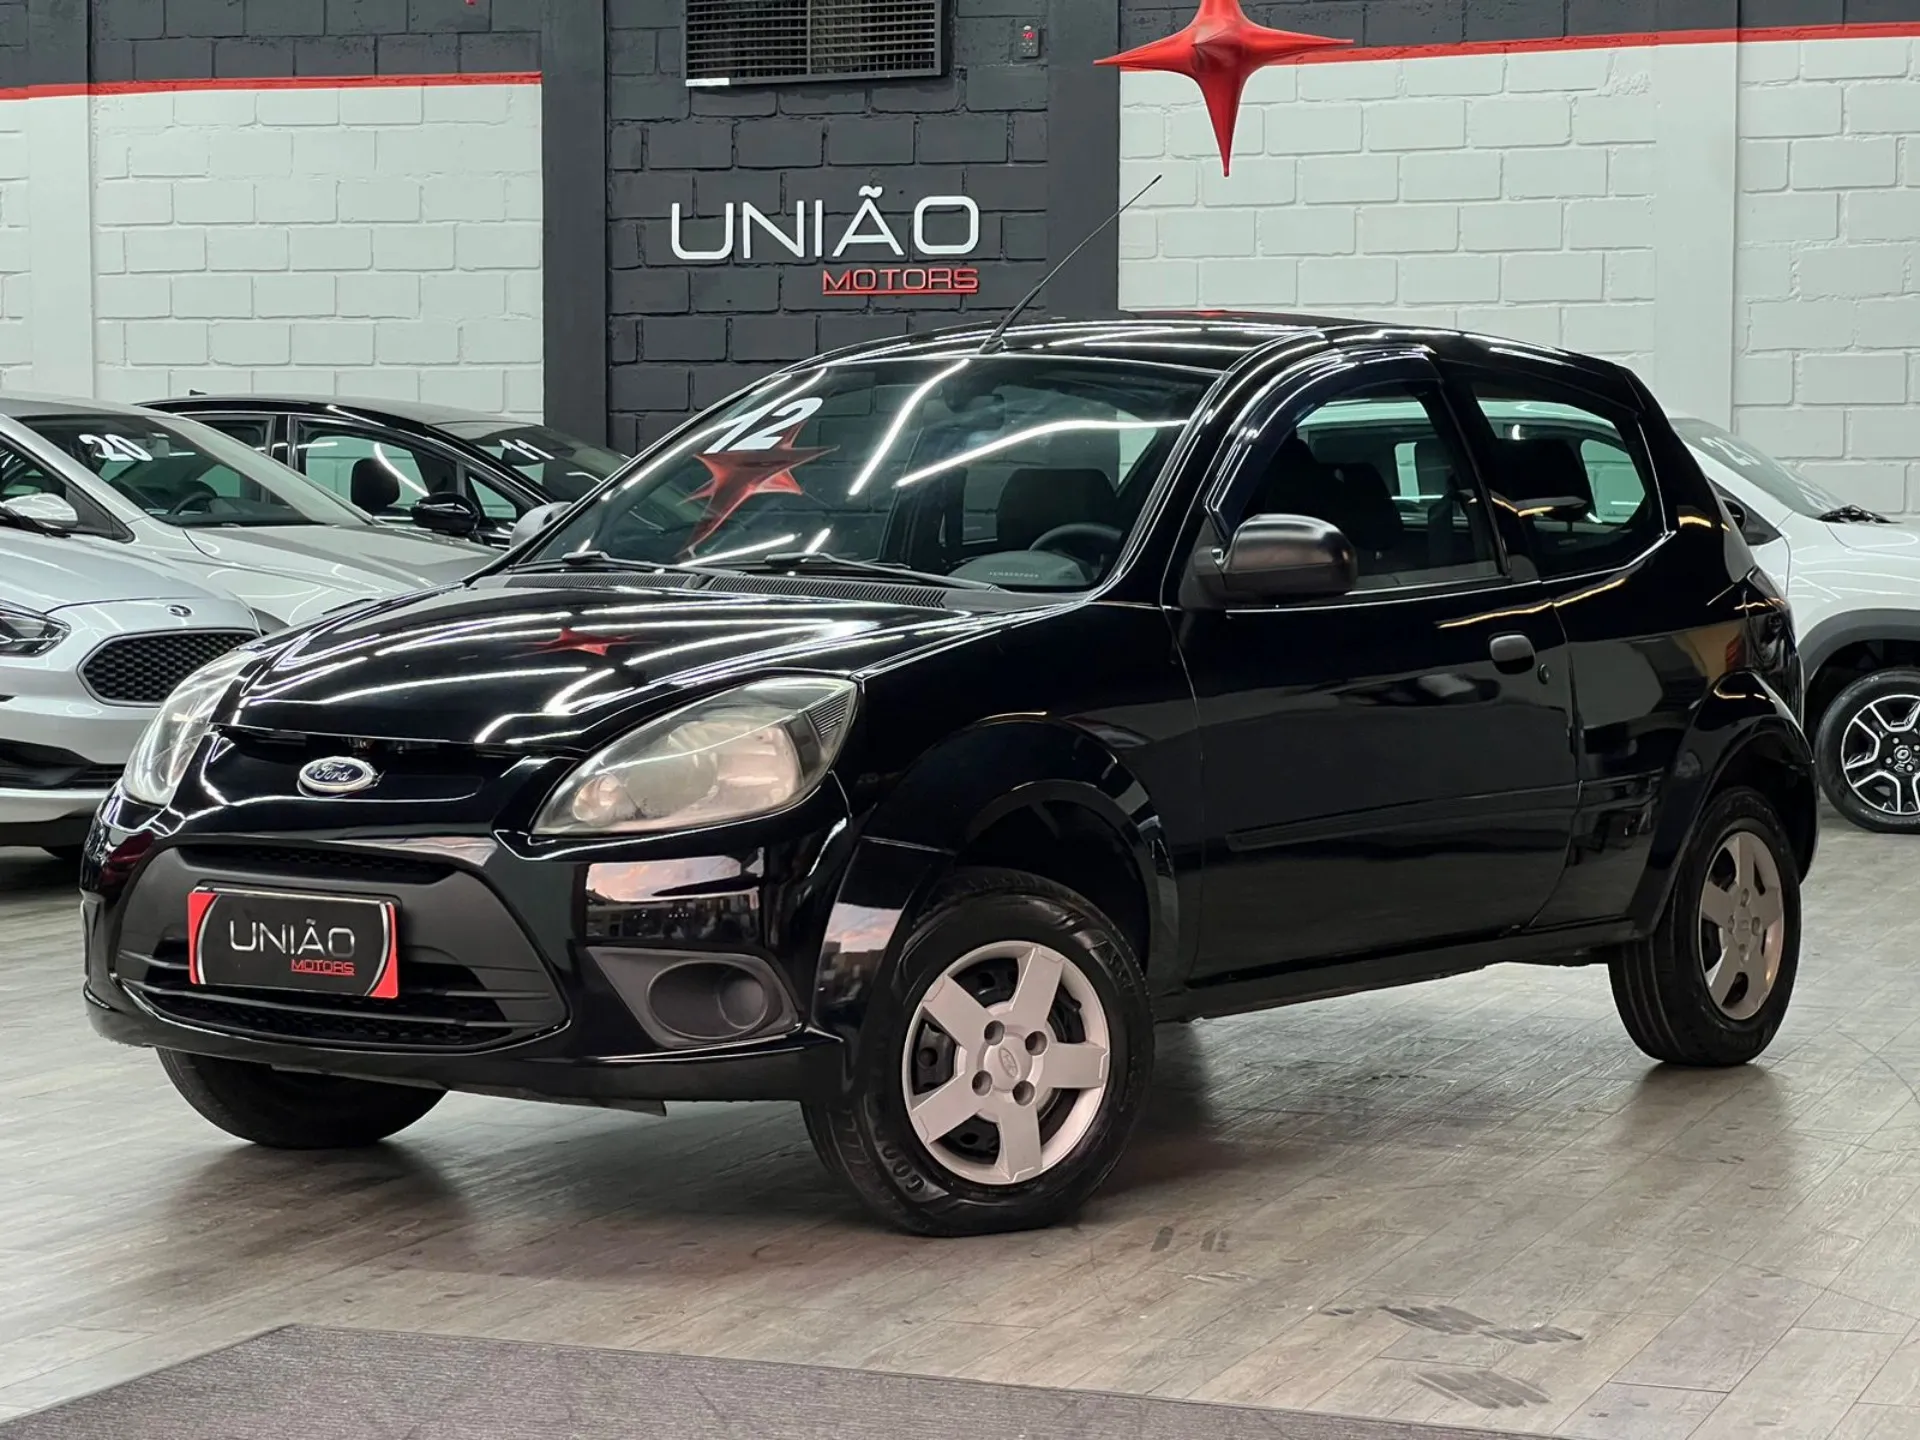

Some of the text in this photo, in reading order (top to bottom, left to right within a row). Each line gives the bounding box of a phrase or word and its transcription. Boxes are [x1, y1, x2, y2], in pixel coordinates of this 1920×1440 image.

[672, 185, 979, 259] UNIÃO
[822, 268, 979, 293] MOTORS
[703, 397, 823, 454] 12
[79, 434, 153, 461] 20
[499, 439, 555, 460] 11
[314, 762, 354, 781] Ford
[229, 918, 355, 958] UNIÃO
[291, 959, 355, 975] MOTORS
